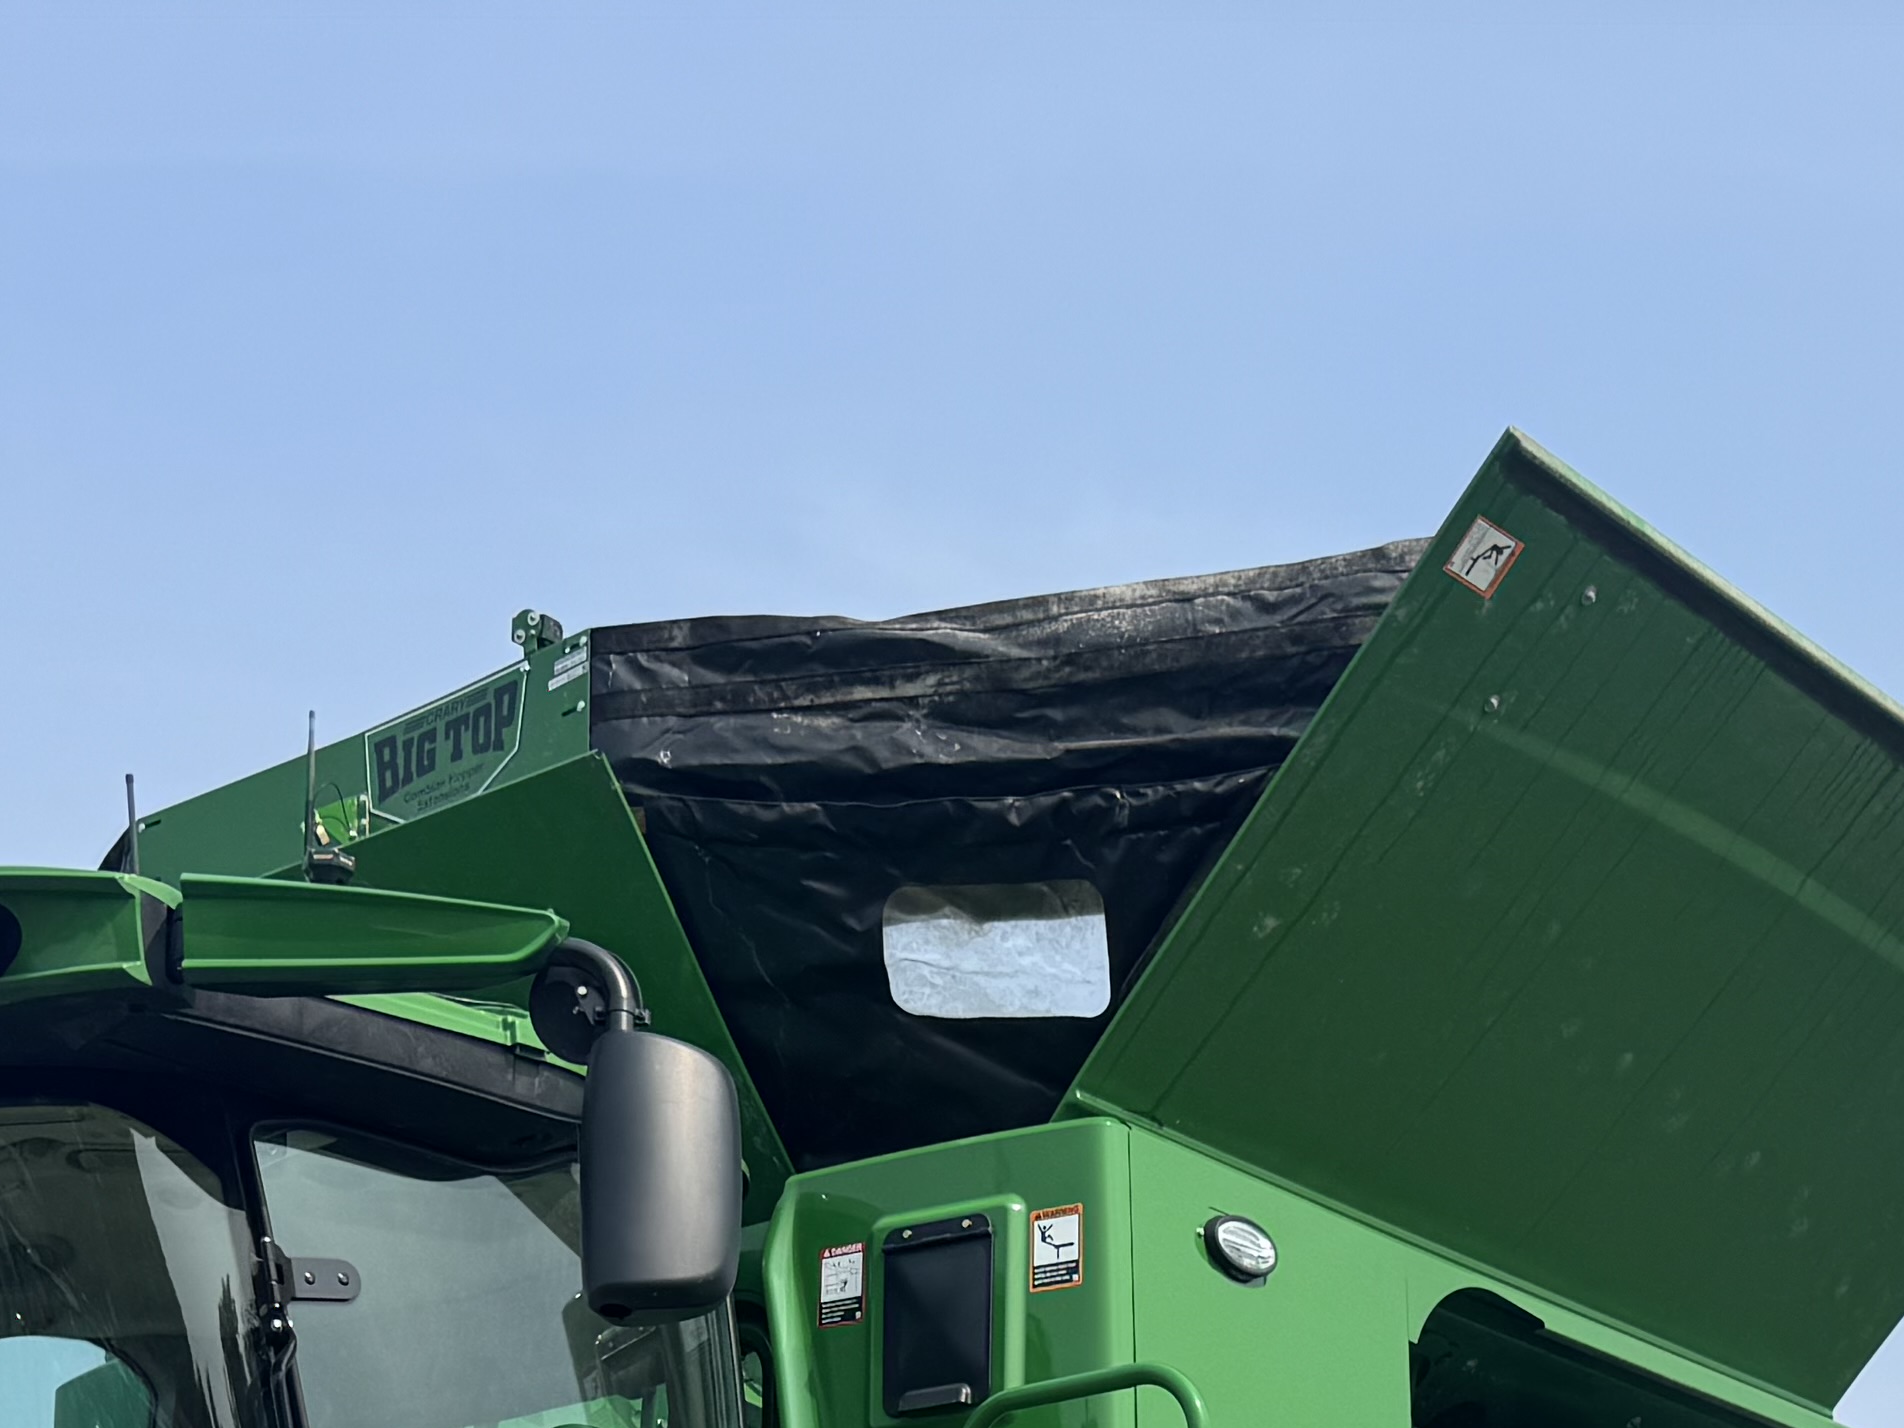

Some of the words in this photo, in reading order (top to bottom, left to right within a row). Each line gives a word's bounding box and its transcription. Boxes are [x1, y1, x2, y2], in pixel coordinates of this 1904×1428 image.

[374, 726, 438, 806] BIG
[445, 679, 519, 763] TOP
[426, 699, 467, 725] CRARY
